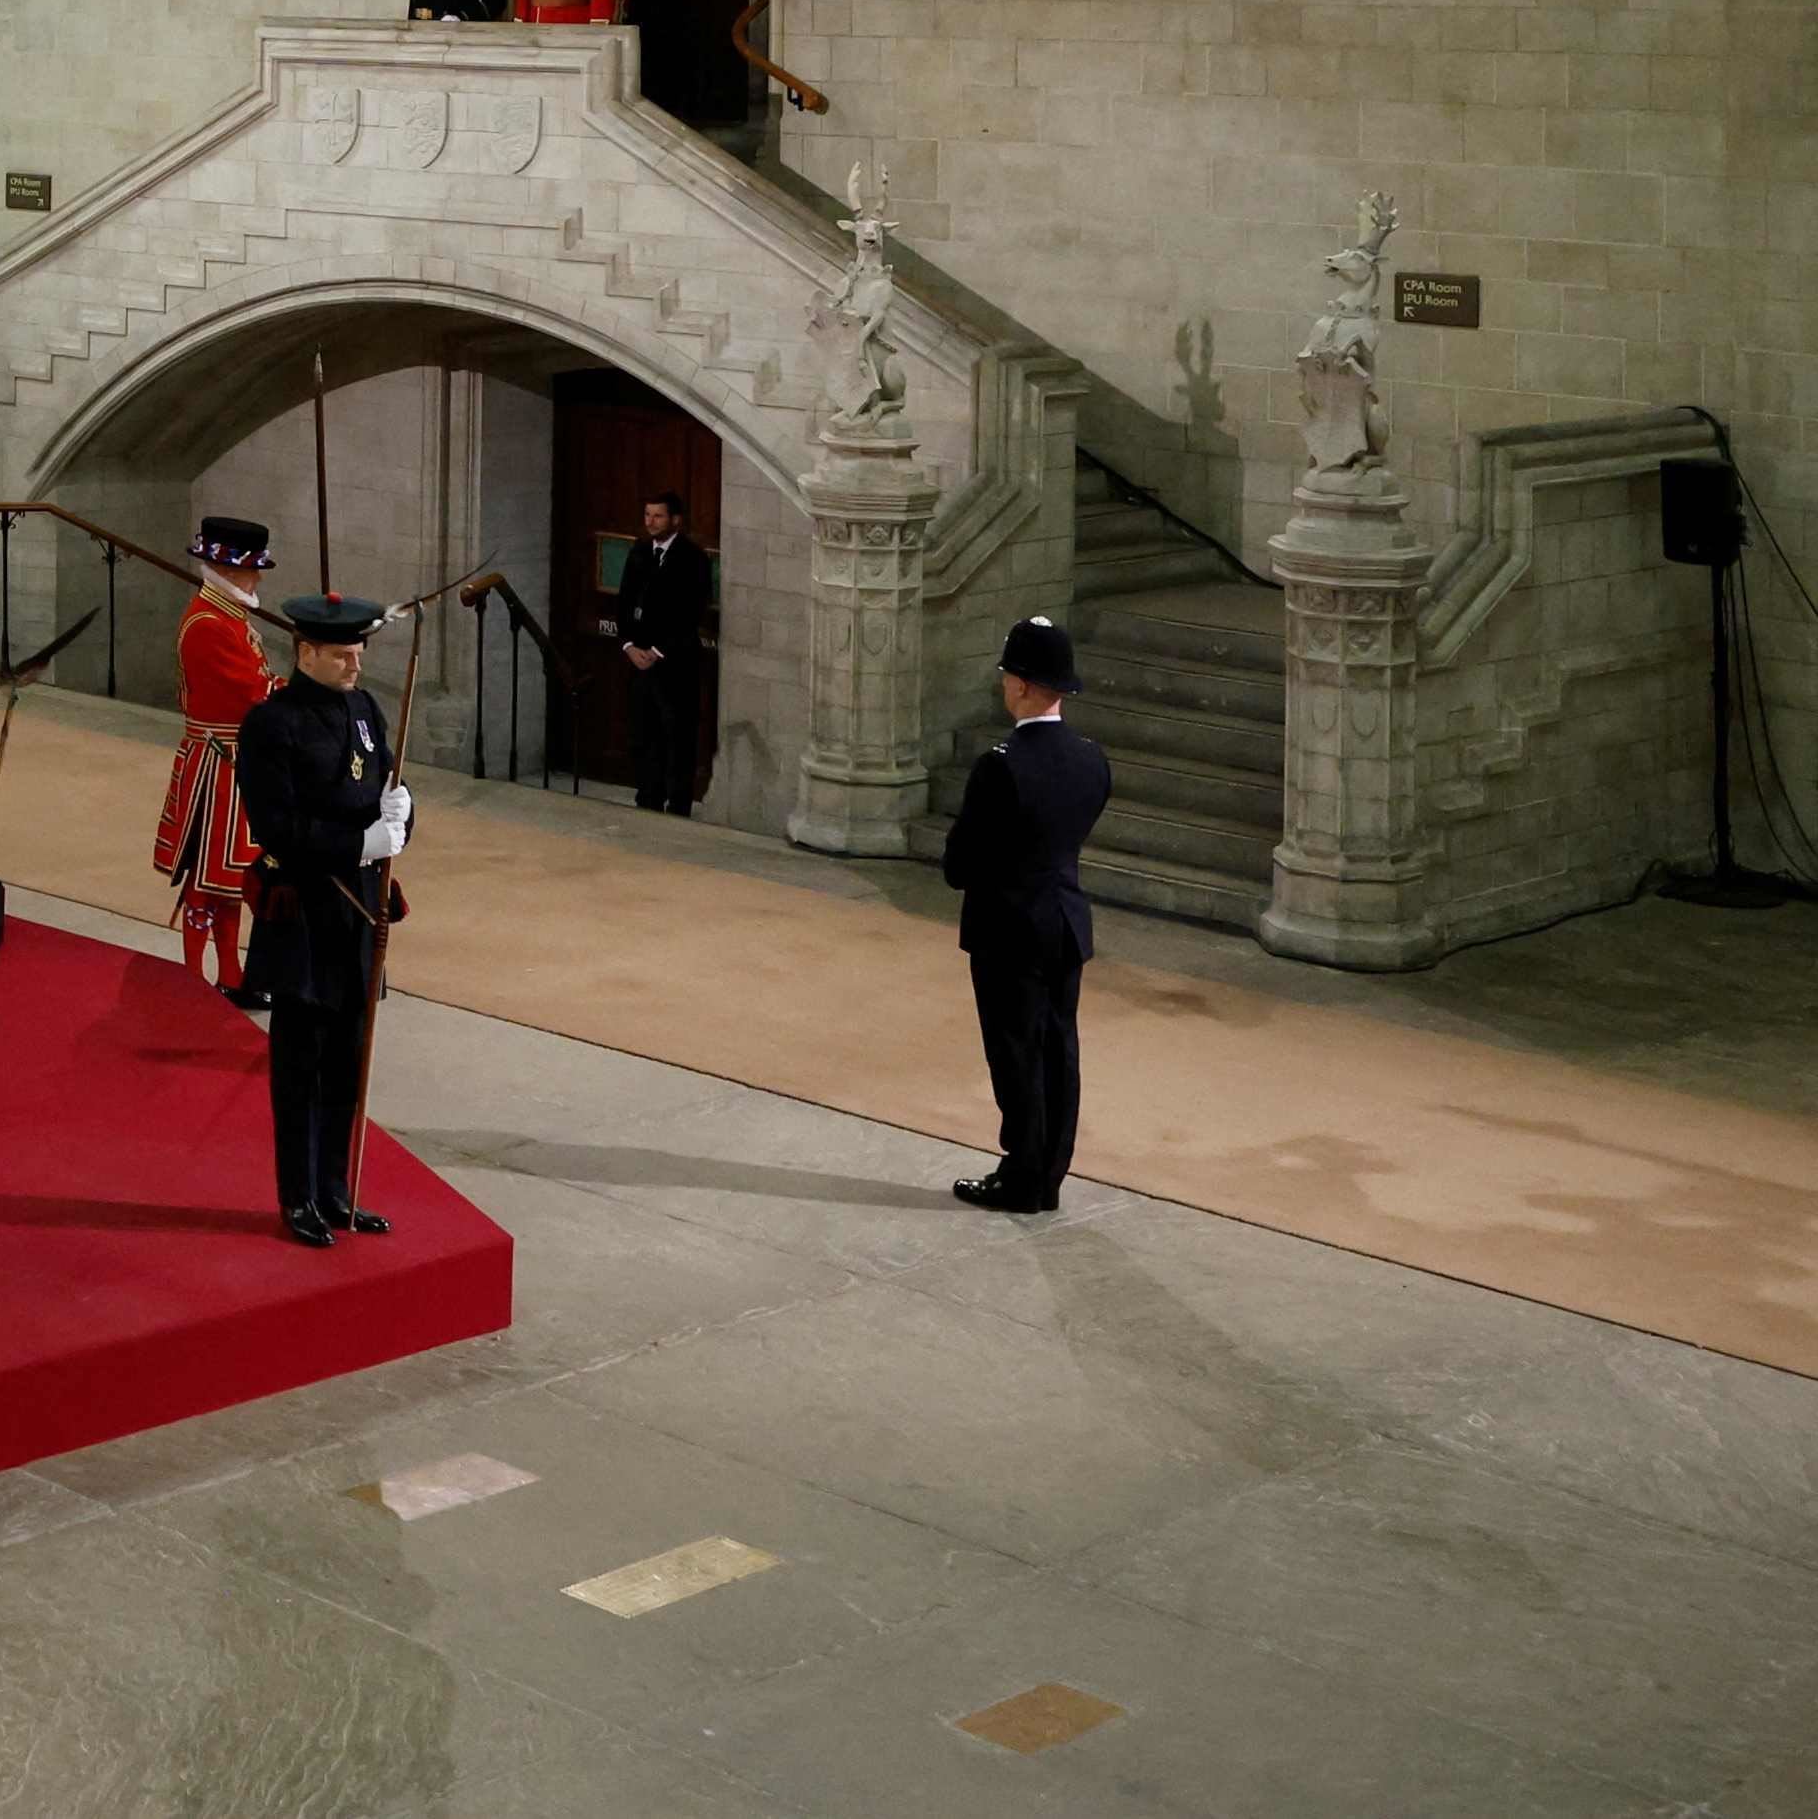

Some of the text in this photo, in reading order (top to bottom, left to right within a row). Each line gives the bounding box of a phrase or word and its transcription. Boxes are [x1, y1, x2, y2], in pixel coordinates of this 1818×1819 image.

[1403, 279, 1462, 294] CPA Room
[1403, 293, 1459, 307] IPU Room
[599, 619, 618, 633] PRIV
